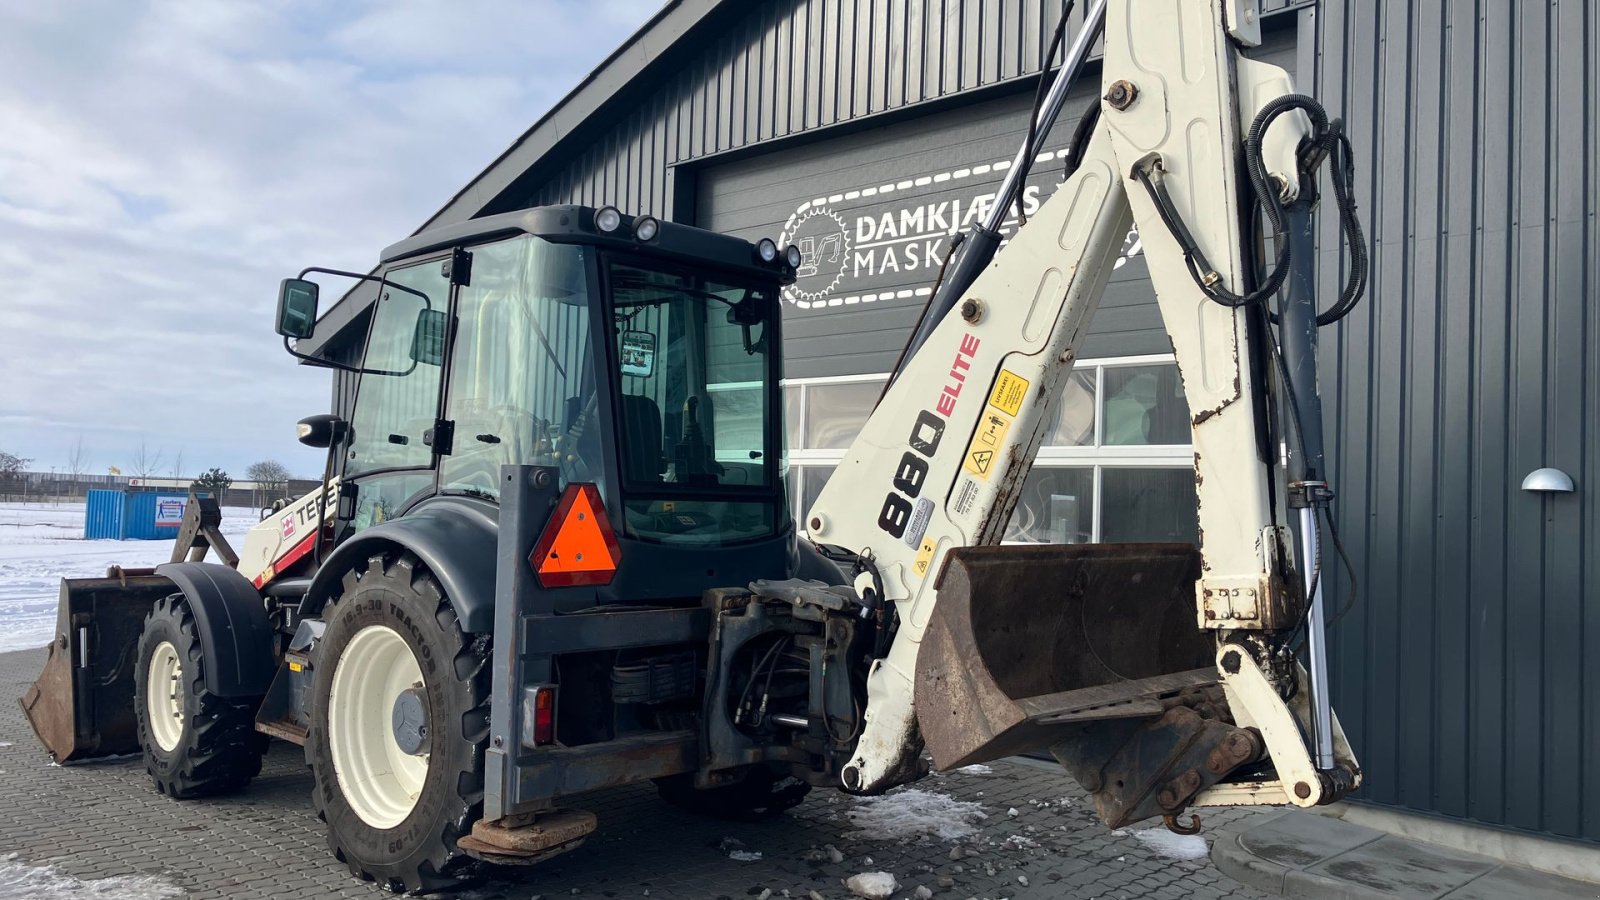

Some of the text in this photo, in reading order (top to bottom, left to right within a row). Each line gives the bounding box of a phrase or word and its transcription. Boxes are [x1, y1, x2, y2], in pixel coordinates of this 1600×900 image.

[855, 185, 1040, 244] DAMKJÆS
[878, 408, 946, 539] 880
[936, 333, 981, 418] ELITE
[389, 602, 436, 674] TRACTOR
